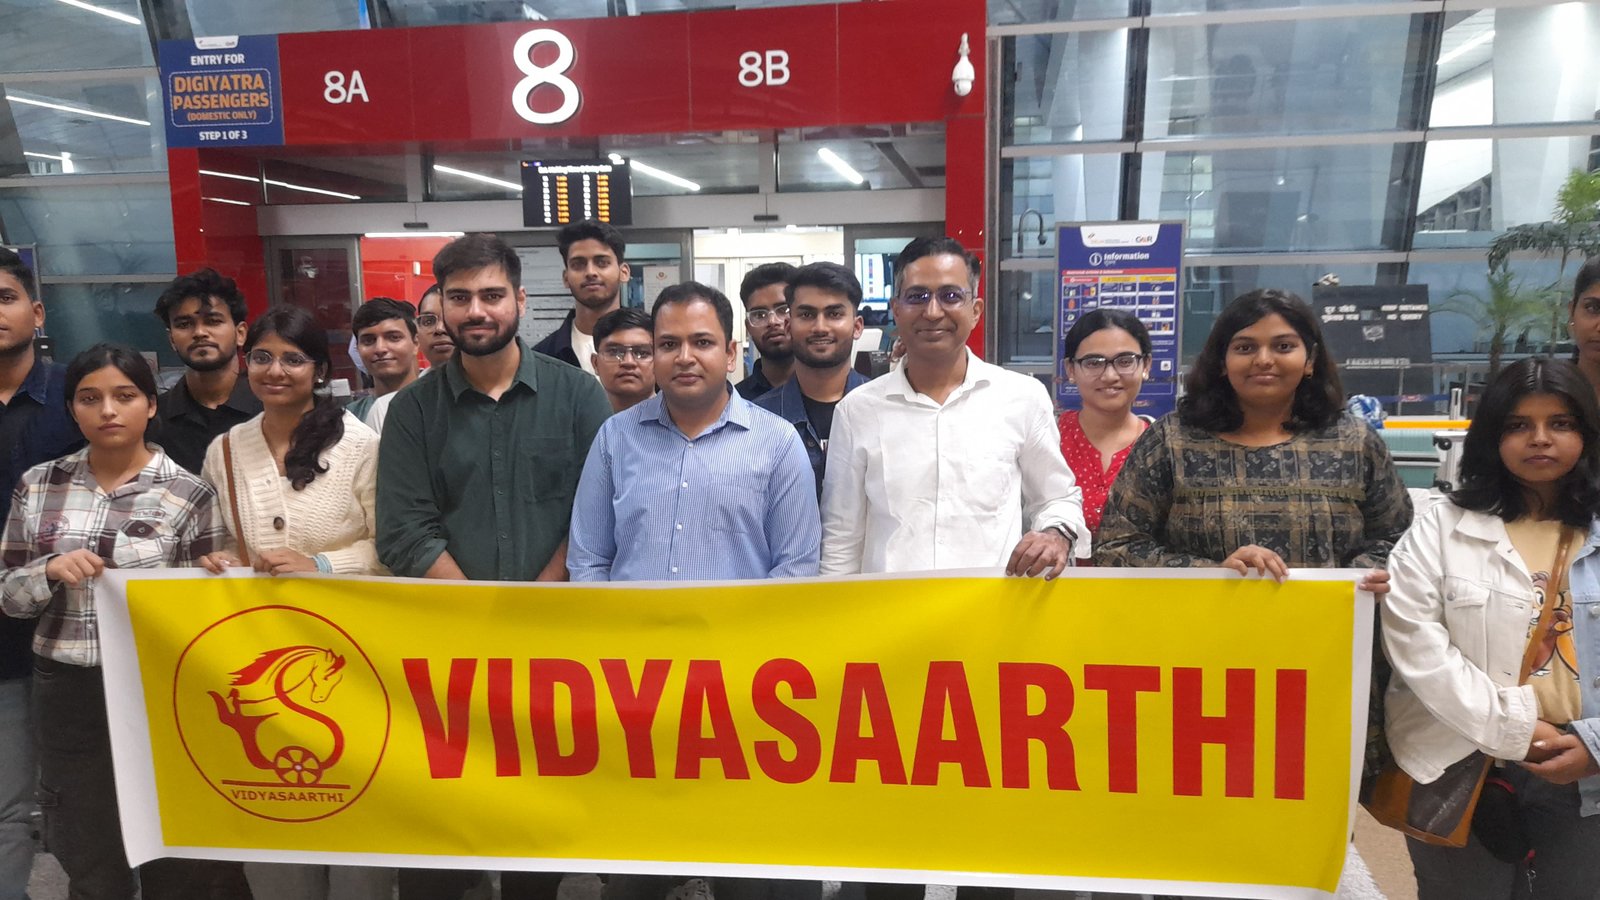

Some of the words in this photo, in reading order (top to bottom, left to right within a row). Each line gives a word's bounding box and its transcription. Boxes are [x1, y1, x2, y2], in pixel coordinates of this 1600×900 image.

[190, 54, 223, 66] ENTRY
[224, 53, 245, 65] FOR
[738, 49, 790, 87] 8B
[174, 73, 265, 93] DIGIYATRA
[511, 28, 583, 125] 8
[323, 70, 370, 104] 8A
[173, 91, 270, 110] PASSENGERS
[187, 111, 231, 122] (DOMESTIC
[232, 110, 257, 120] ONLY)
[199, 131, 221, 141] STEP
[222, 131, 227, 140] 1
[228, 130, 240, 140] OF
[241, 130, 248, 140] 3
[1103, 252, 1150, 261] Information
[401, 657, 1307, 800] VIDYASAARTHI
[230, 789, 345, 803] VIDYASAARTHI
